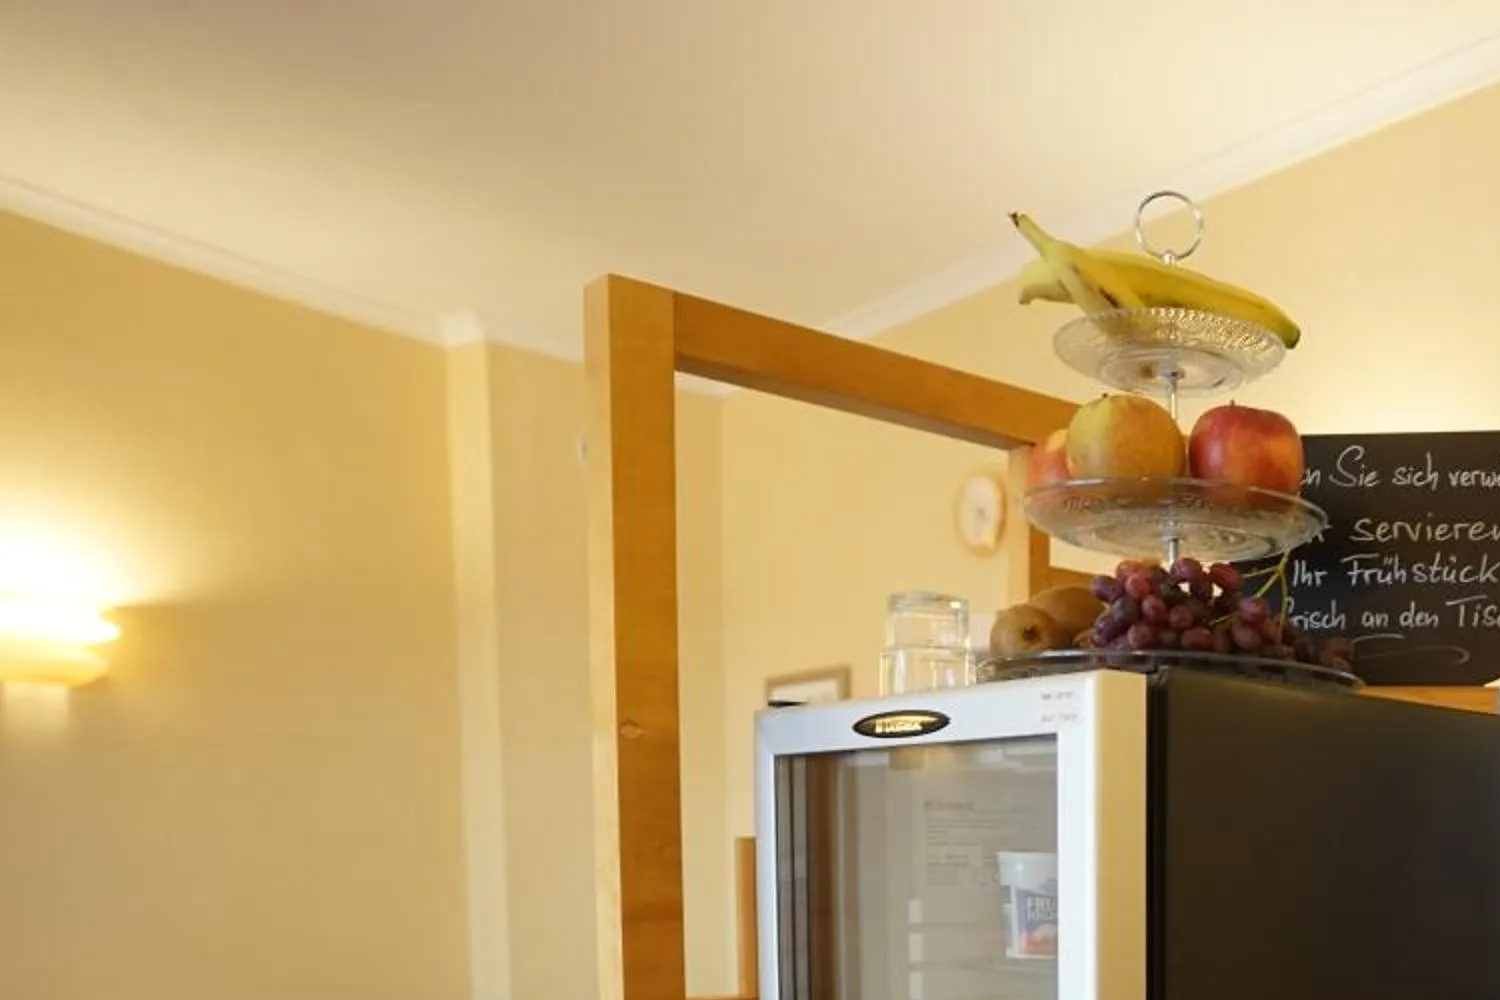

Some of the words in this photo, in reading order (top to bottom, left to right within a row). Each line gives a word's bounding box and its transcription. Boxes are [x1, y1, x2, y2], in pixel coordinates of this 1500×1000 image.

[1328, 444, 1381, 488] Sie
[1391, 450, 1439, 491] sich
[1292, 559, 1329, 587] Ihr
[1360, 610, 1389, 629] an
[1399, 600, 1440, 628] den
